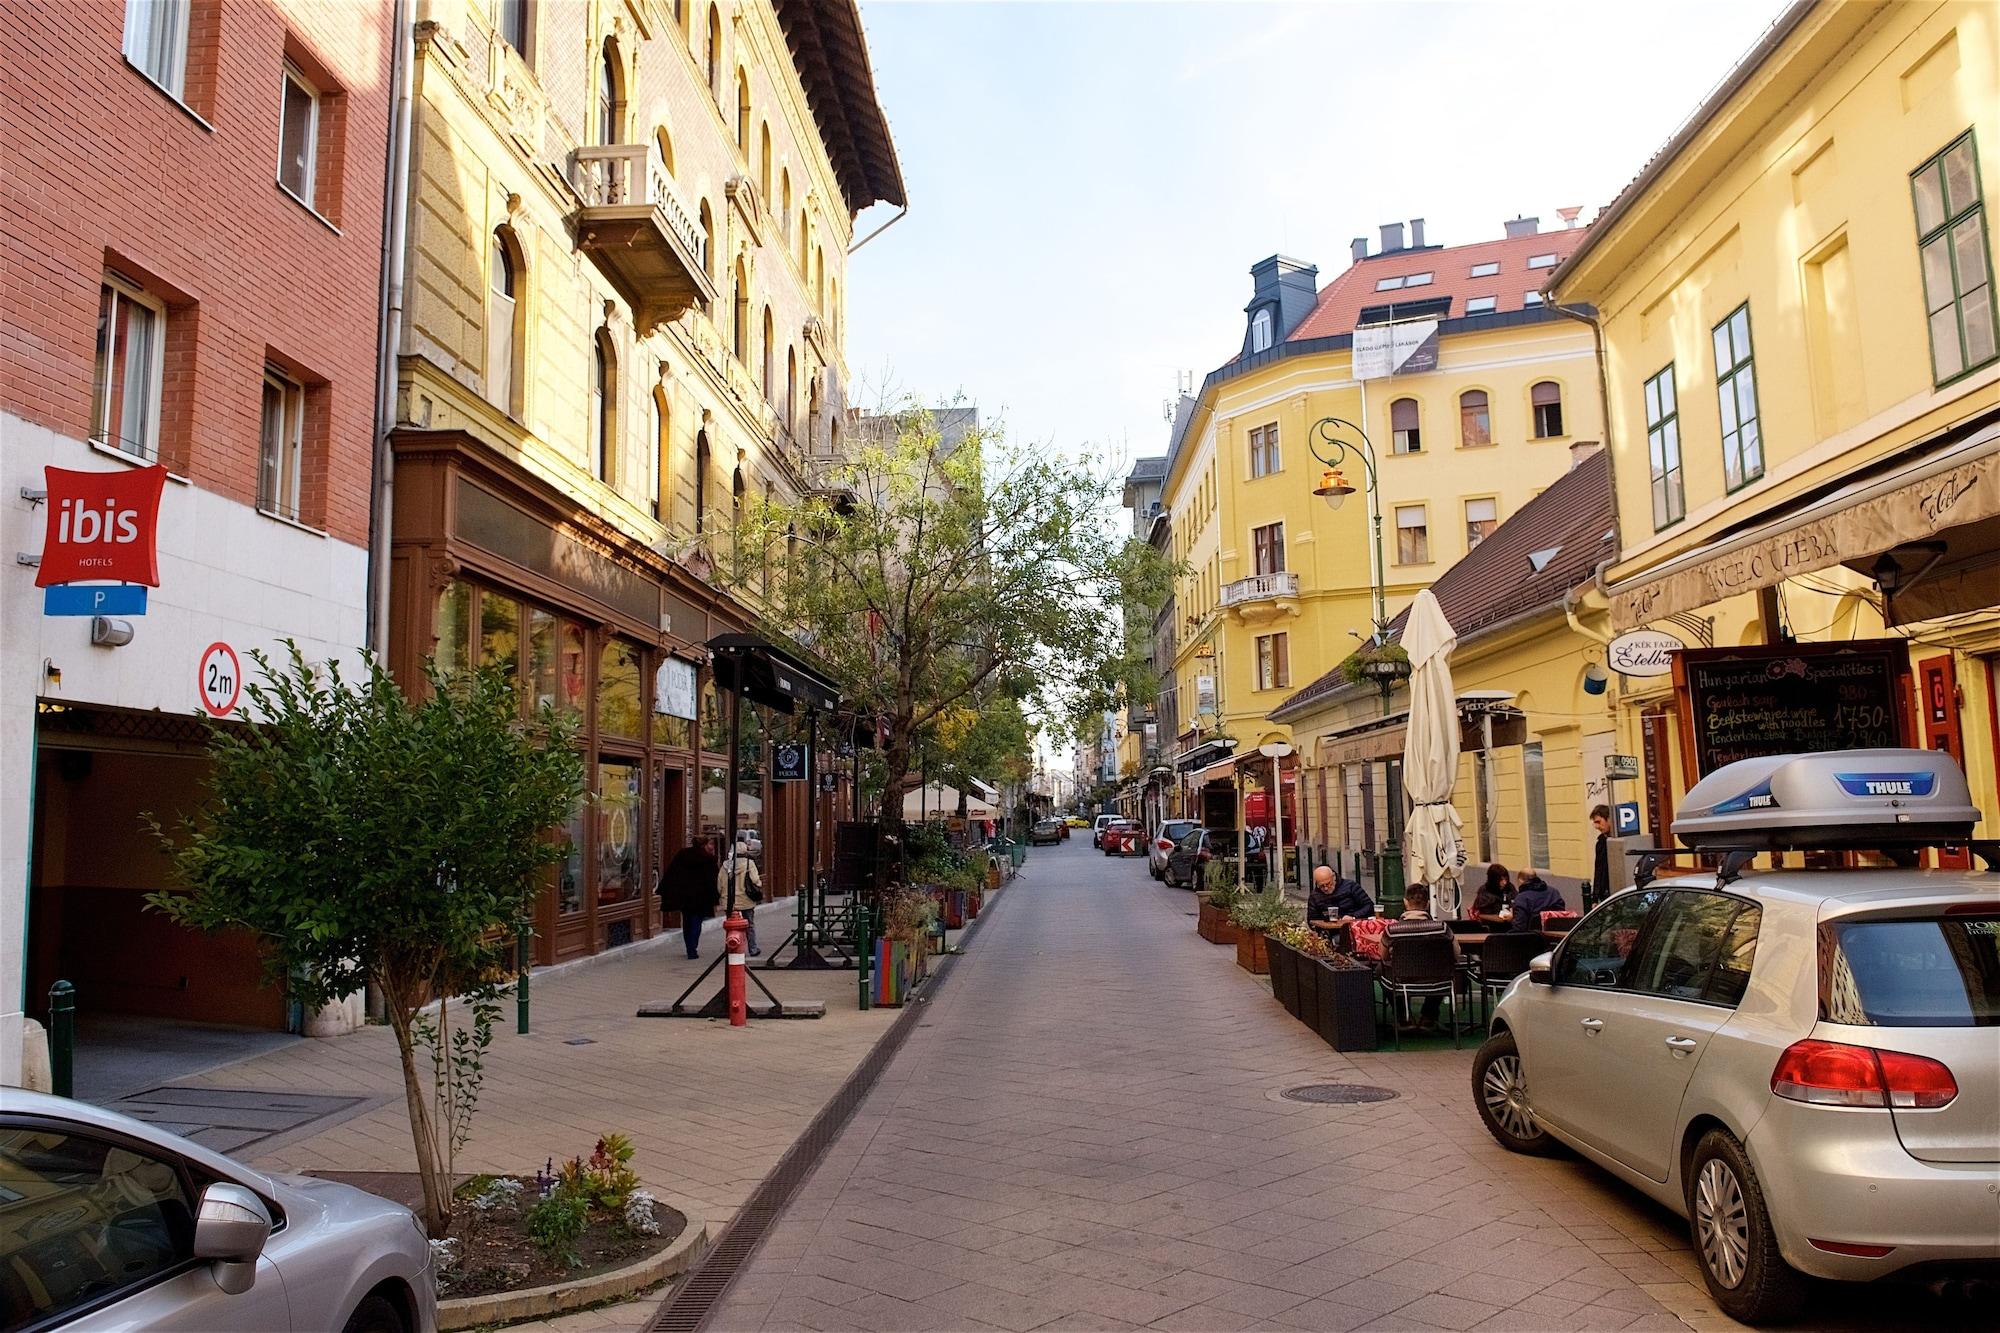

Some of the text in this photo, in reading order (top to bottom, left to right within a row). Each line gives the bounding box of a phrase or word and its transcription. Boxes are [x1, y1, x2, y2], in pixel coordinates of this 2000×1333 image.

[58, 498, 138, 544] ibis
[79, 558, 113, 567] HOTELS
[94, 592, 106, 609] P
[1634, 639, 1680, 649] KÉK FAZÉK
[1613, 642, 1673, 668] Ételbá
[1698, 669, 1768, 690] Hungarian
[1707, 709, 1735, 730] Beef
[1757, 715, 1826, 731] with noodles
[1865, 781, 1913, 794] THULE
[1749, 795, 1772, 807] THULE
[1619, 807, 1635, 828] P
[1964, 921, 2000, 930] POR
